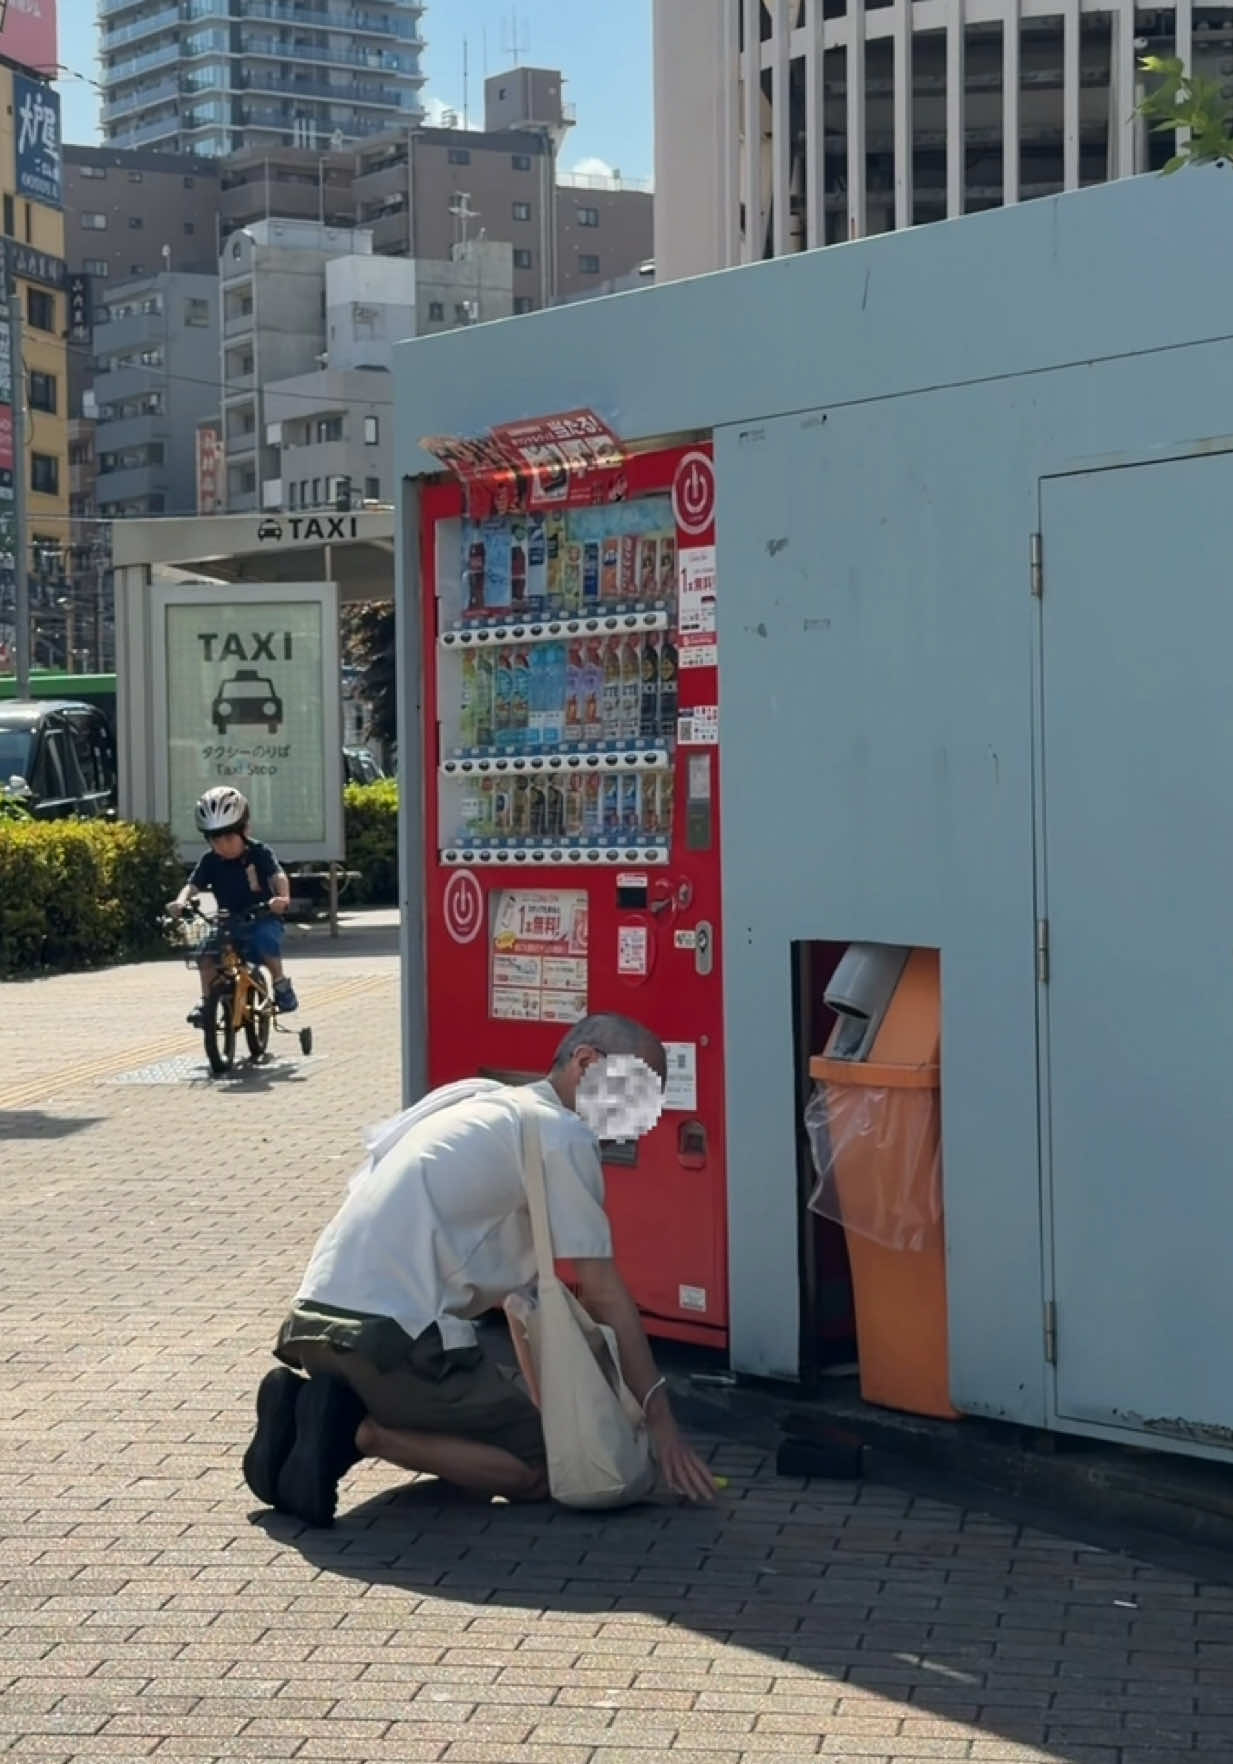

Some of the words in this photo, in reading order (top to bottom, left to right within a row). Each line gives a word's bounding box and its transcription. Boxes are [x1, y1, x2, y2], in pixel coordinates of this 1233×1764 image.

[288, 517, 357, 539] TAXI
[197, 631, 292, 662] TAXI
[201, 744, 291, 759] タクシーのりば
